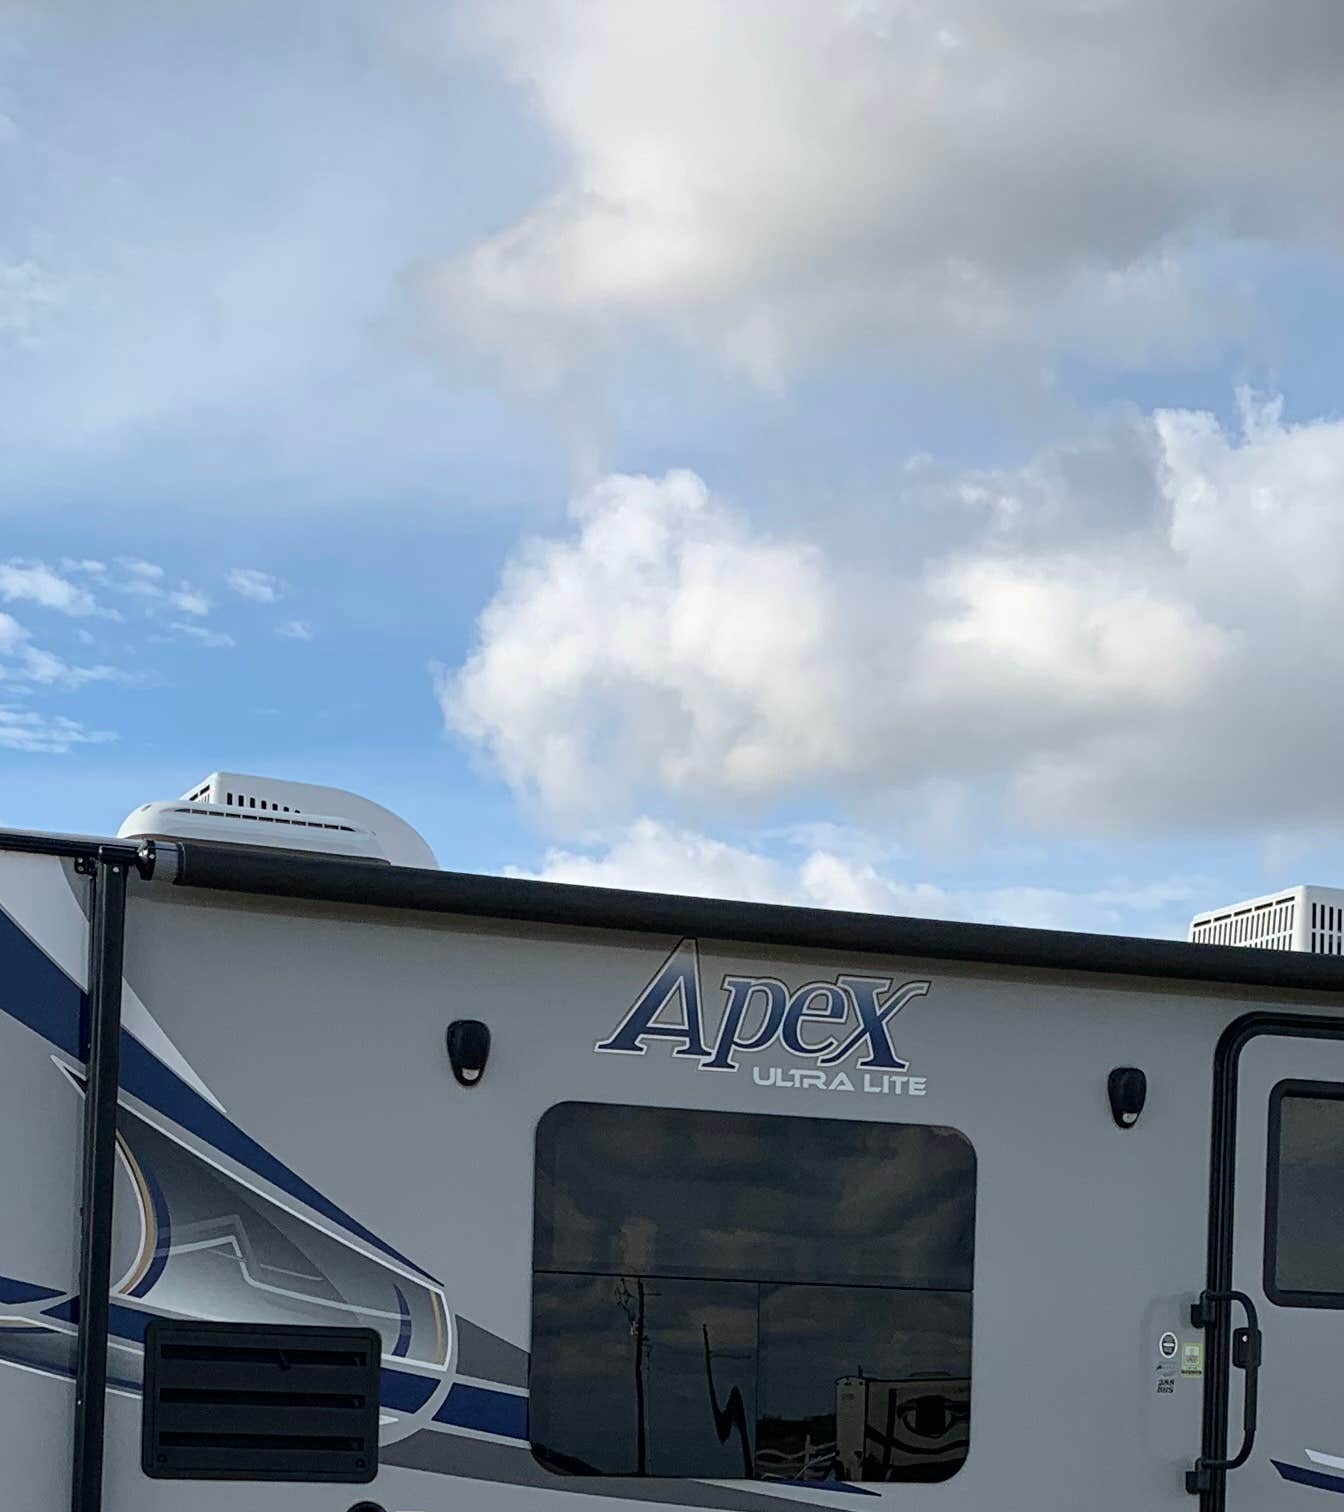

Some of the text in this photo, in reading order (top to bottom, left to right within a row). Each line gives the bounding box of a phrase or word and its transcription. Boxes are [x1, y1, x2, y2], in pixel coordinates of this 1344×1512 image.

[594, 936, 932, 1072] Apex
[753, 1066, 927, 1096] ULTRA LITE
